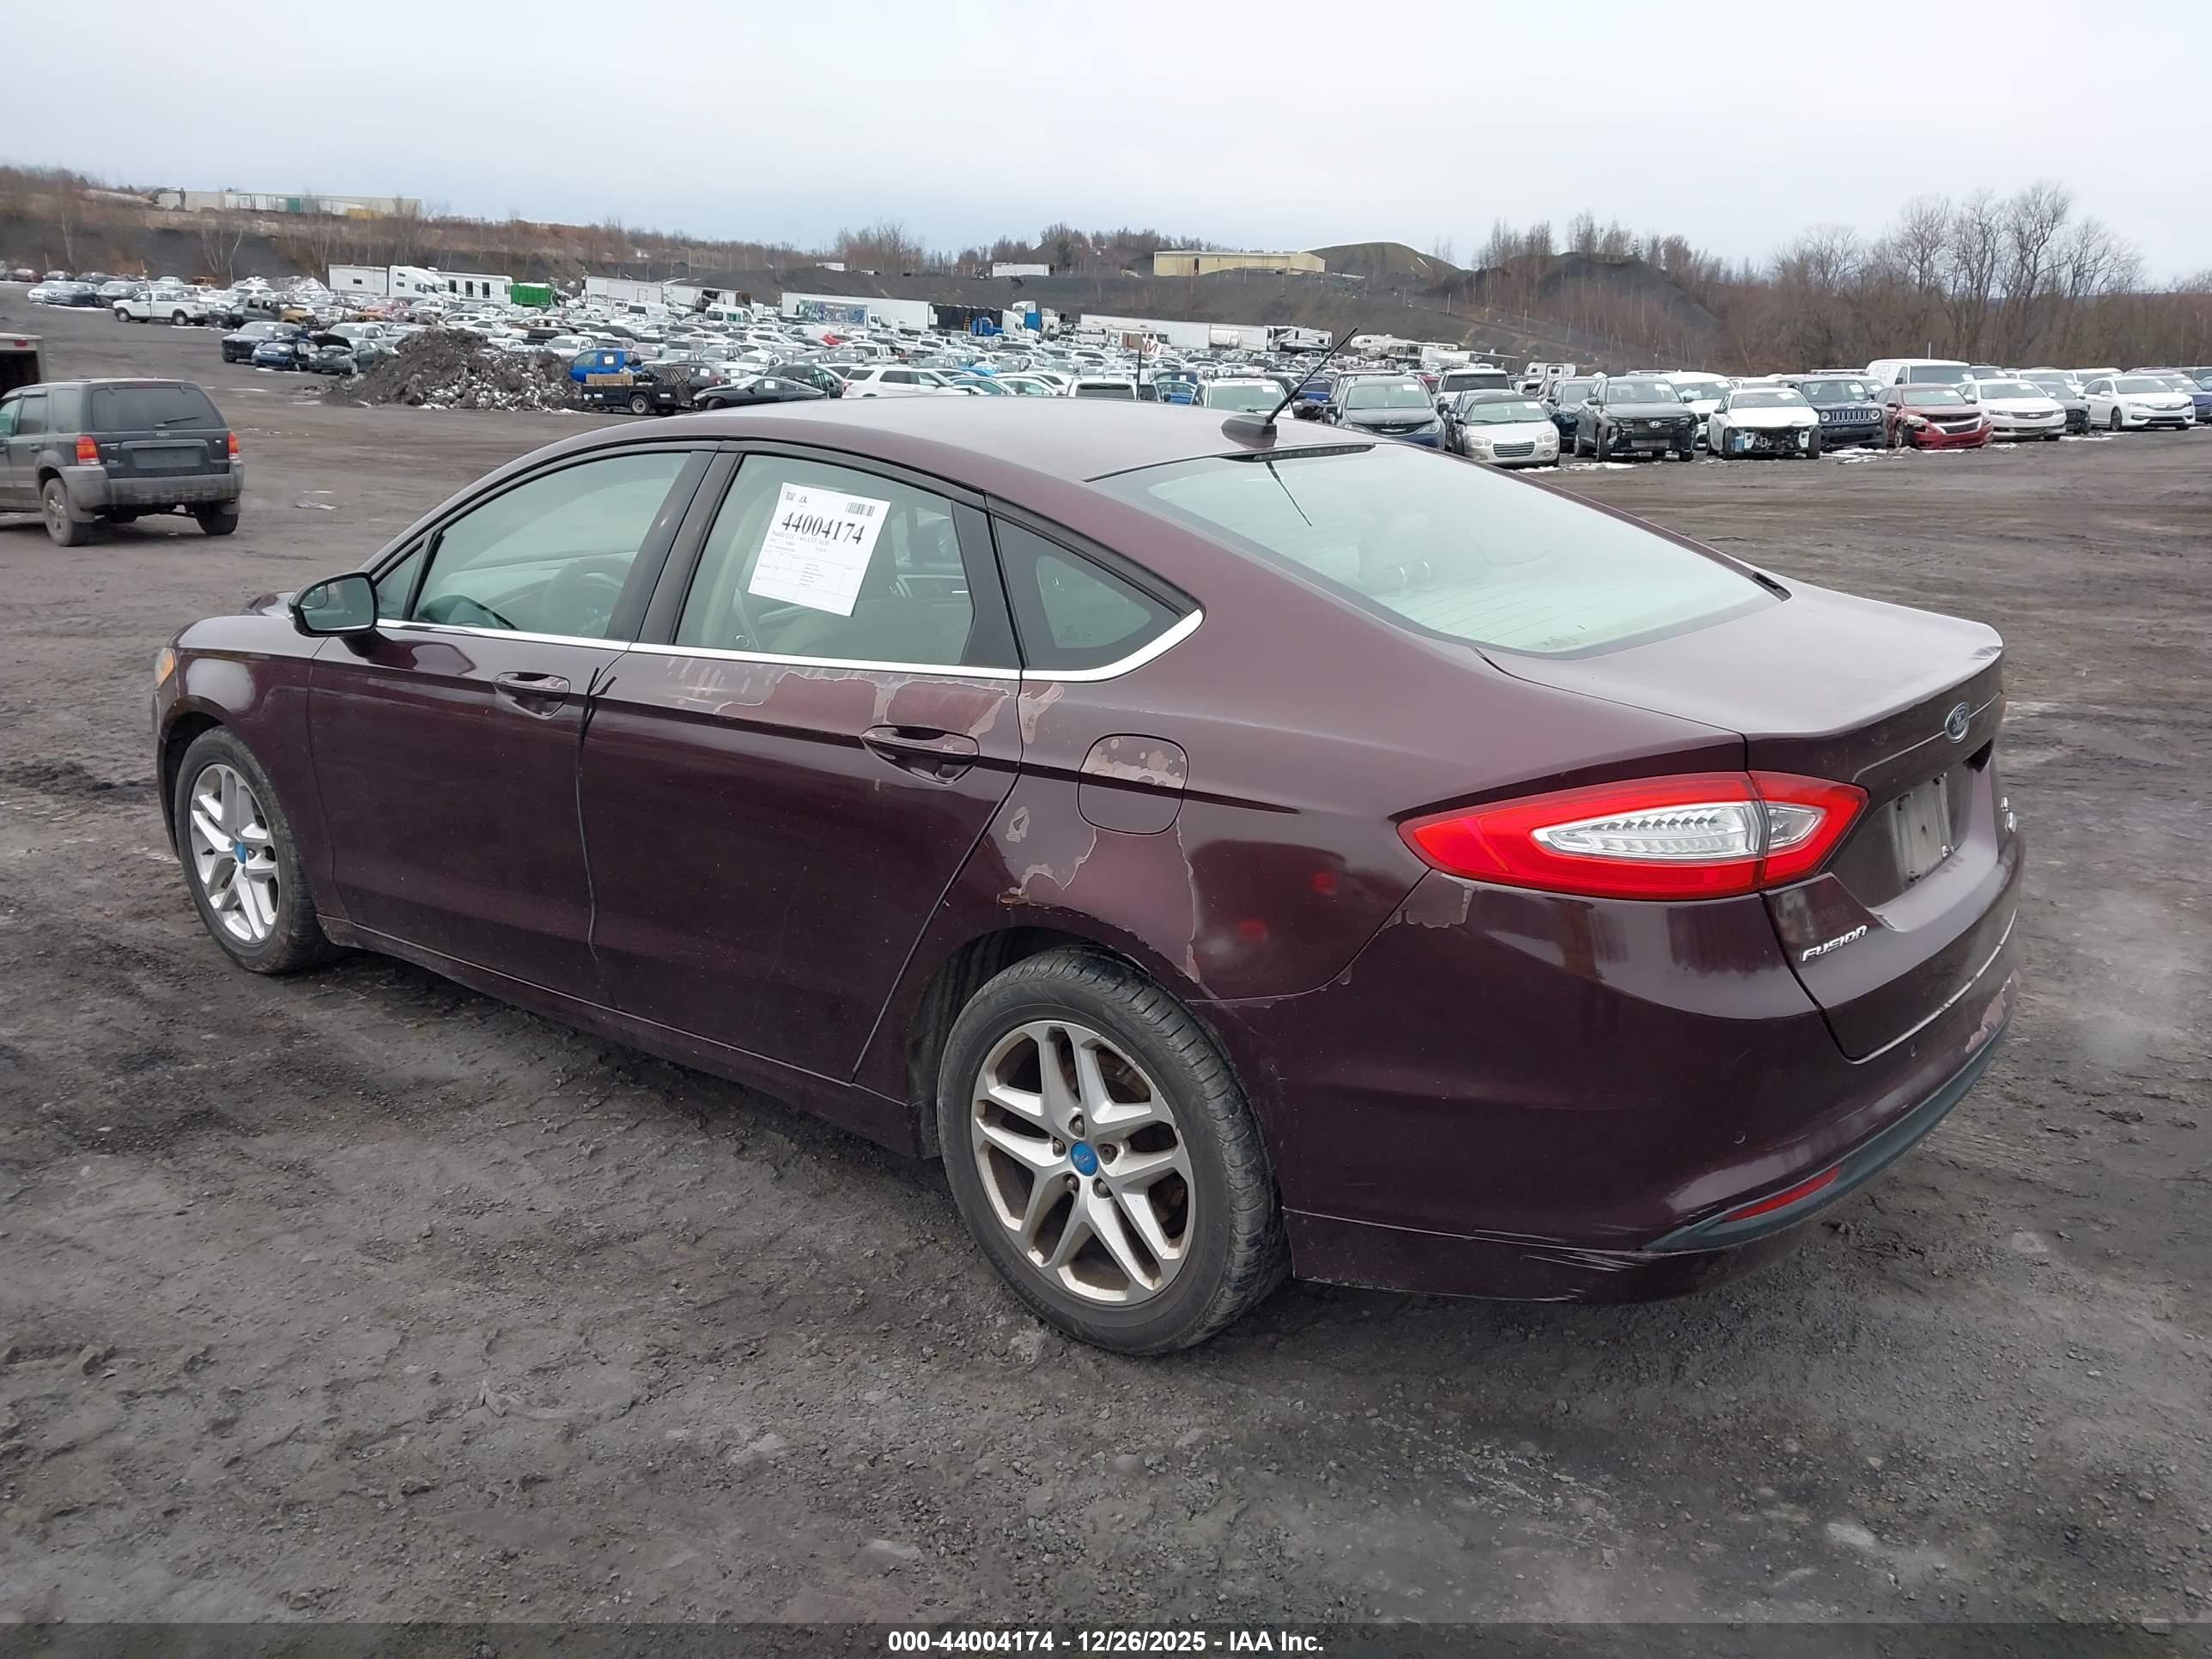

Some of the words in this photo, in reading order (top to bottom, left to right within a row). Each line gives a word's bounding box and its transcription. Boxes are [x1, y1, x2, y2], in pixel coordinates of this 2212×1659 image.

[1145, 340, 1158, 354] M
[781, 511, 866, 544] 44004174
[1802, 925, 1868, 962] FUSION
